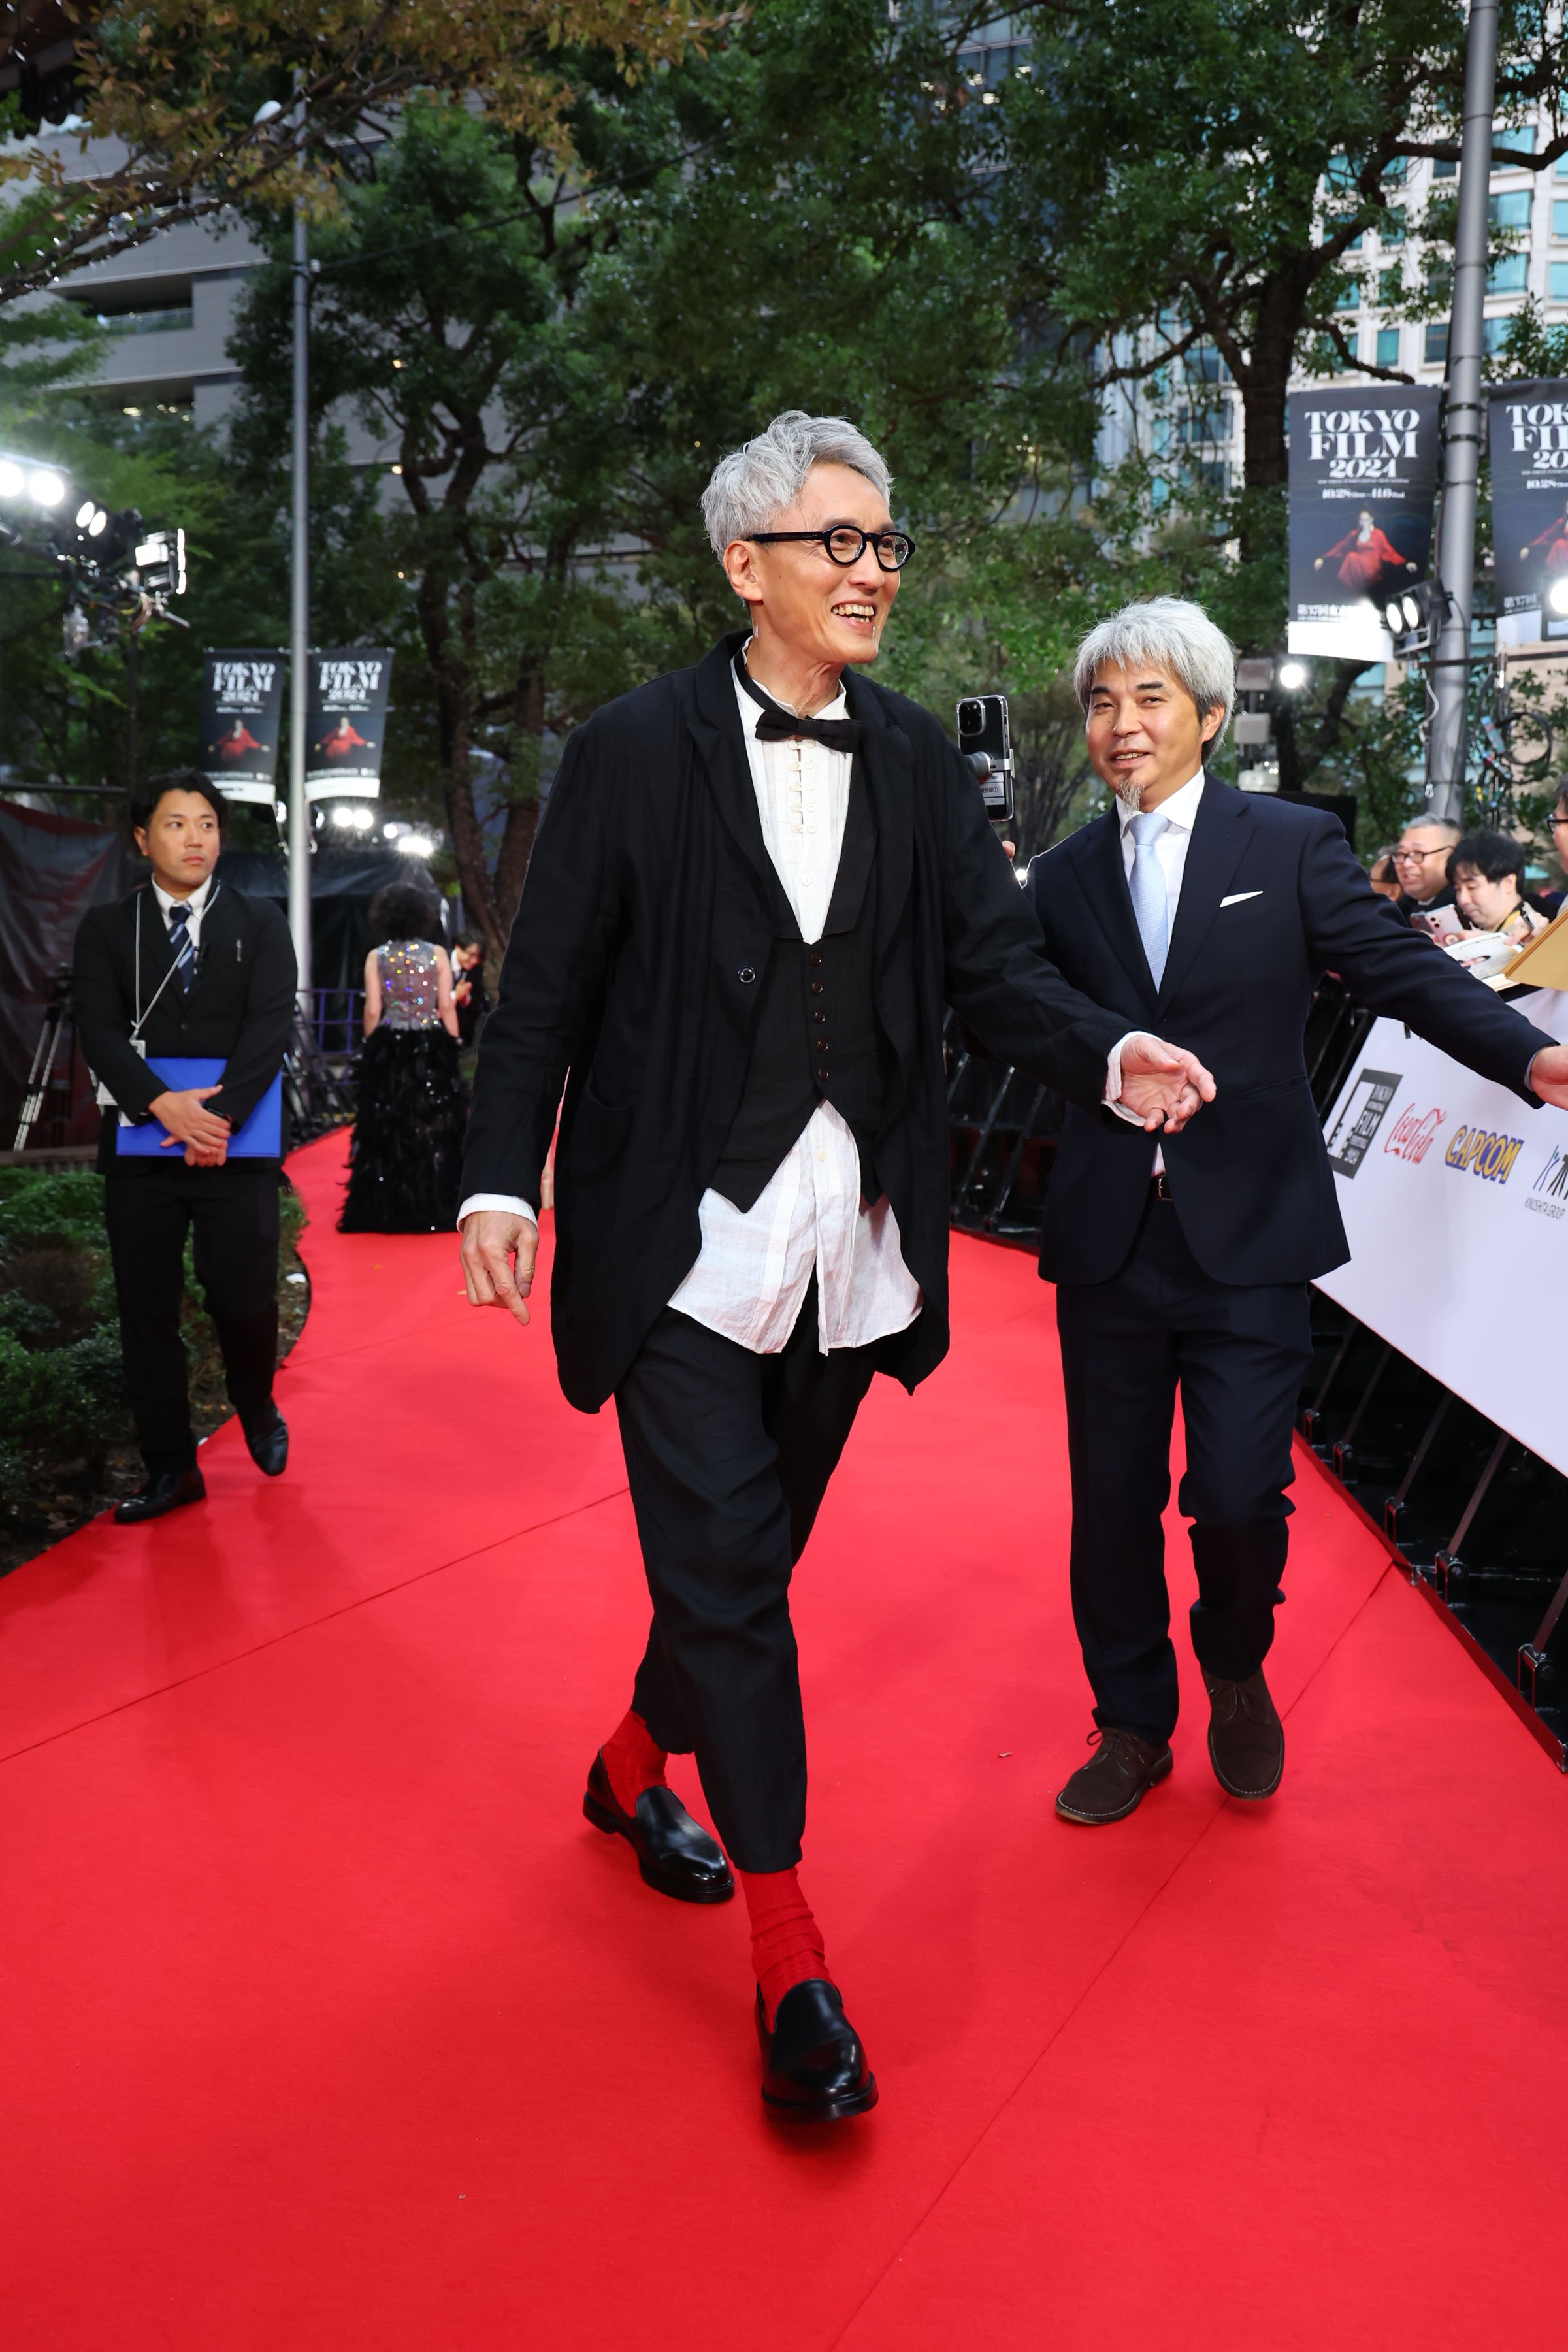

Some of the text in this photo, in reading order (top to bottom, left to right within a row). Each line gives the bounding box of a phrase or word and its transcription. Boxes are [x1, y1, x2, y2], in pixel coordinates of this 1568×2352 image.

[1304, 408, 1420, 433] TOKYO
[1309, 431, 1418, 460] FILM
[1329, 458, 1396, 478] 2024
[212, 662, 276, 676] TOKYO
[319, 661, 382, 675] TOKYO
[213, 674, 272, 691] FILM
[319, 672, 379, 690] FILM
[1445, 1125, 1524, 1184] CAPCOM
